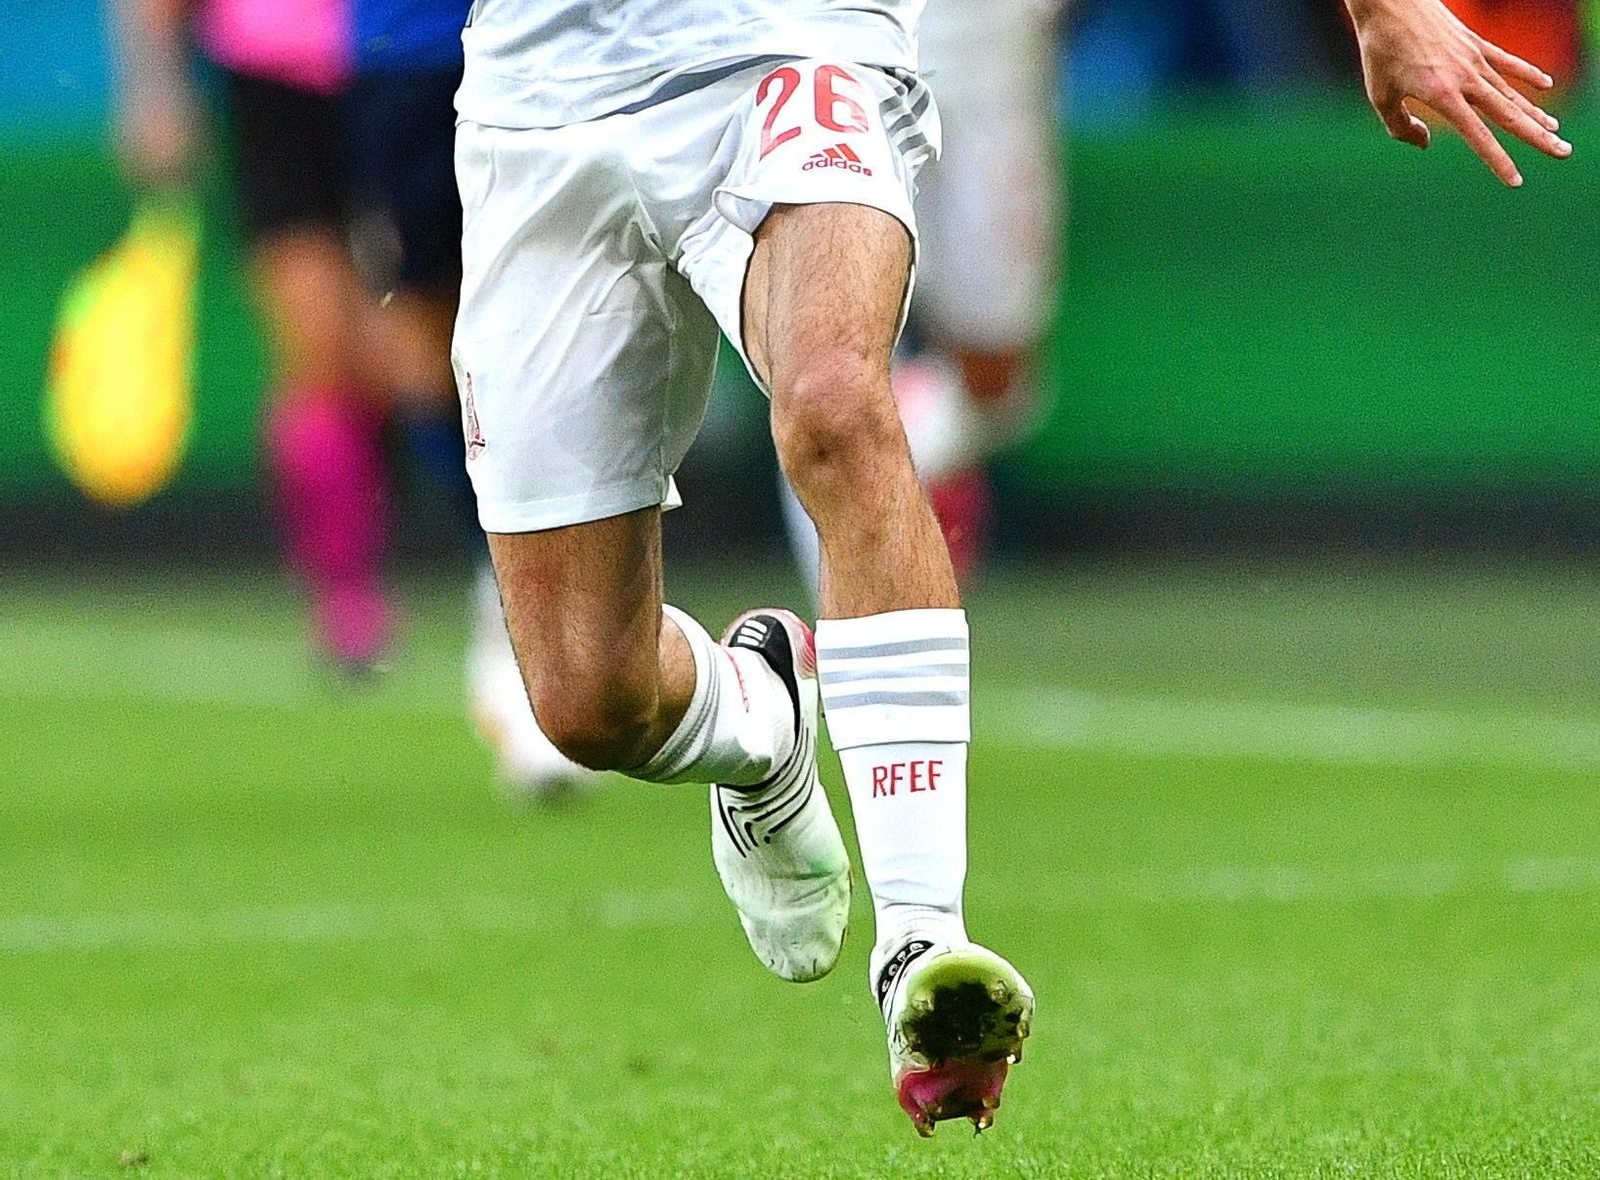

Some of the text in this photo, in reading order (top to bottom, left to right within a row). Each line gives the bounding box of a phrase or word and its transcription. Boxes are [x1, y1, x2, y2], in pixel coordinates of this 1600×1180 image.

[756, 64, 869, 163] 26
[802, 156, 873, 177] adidas
[872, 760, 943, 799] RFEF
